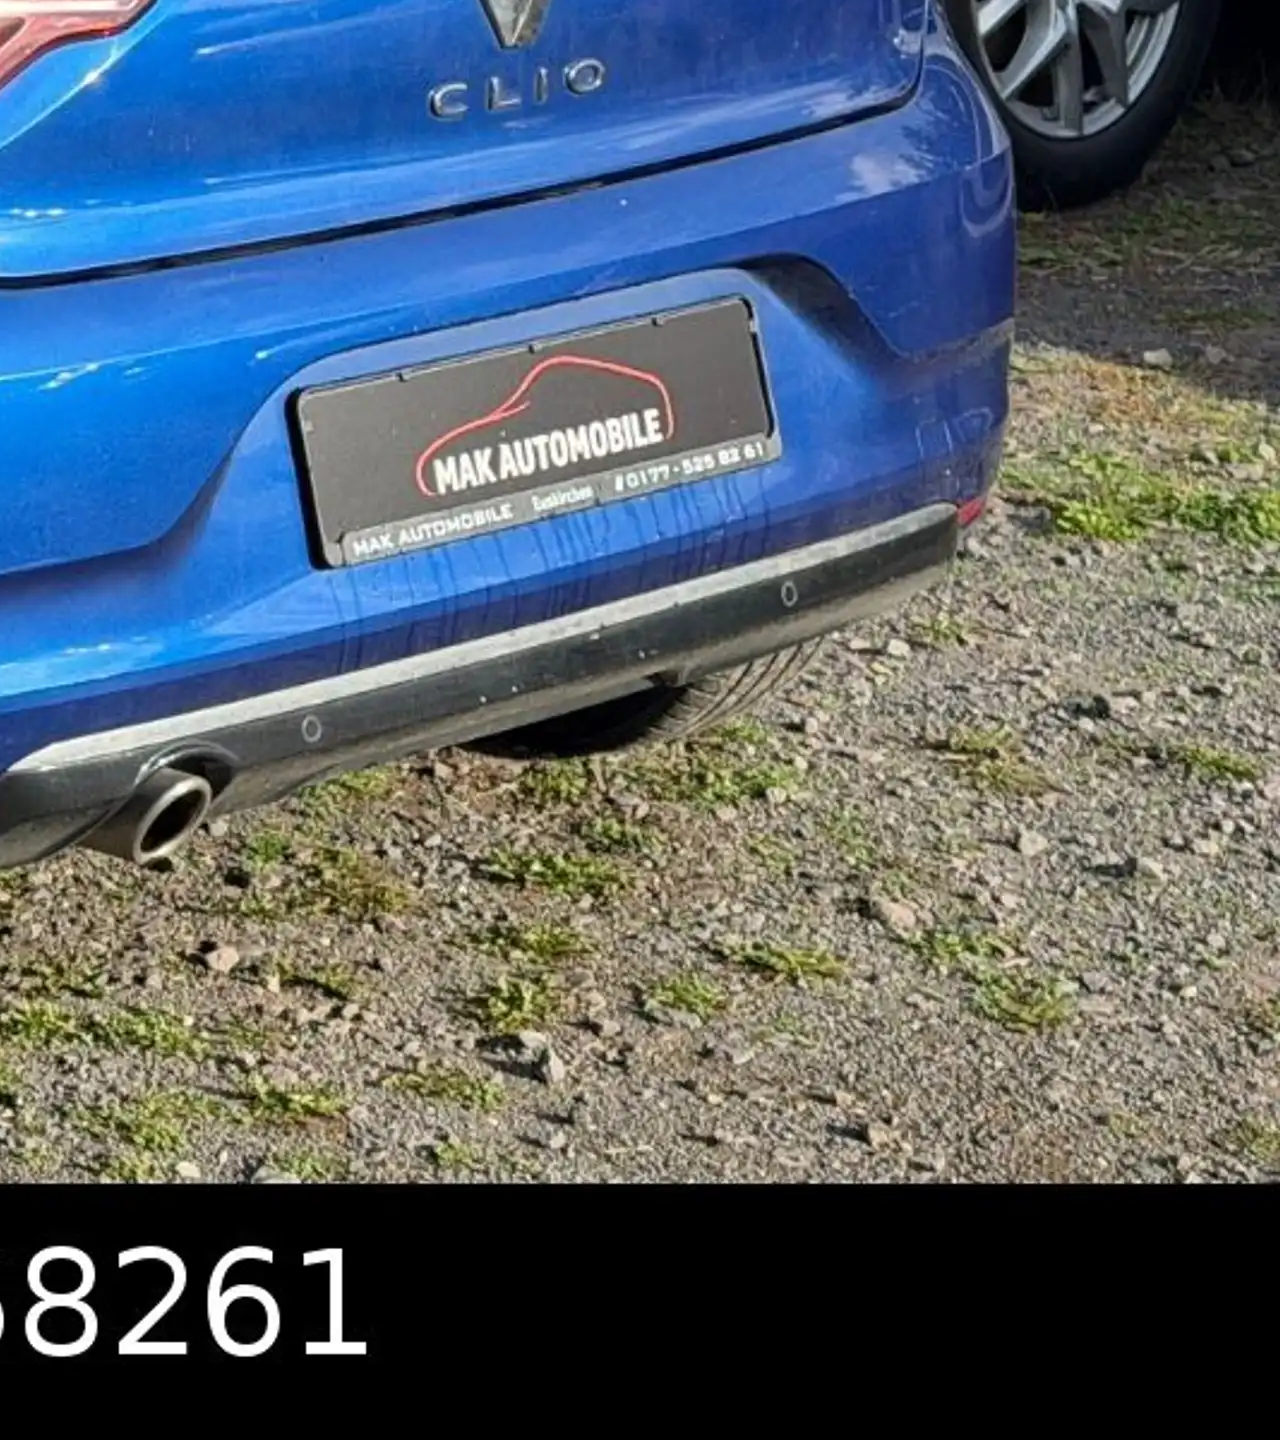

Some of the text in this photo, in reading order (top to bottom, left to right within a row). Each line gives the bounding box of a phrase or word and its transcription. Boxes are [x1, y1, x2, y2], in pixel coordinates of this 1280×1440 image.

[428, 58, 606, 121] CLIO
[433, 408, 663, 495] MAK AUTOMOBILE
[352, 534, 393, 557] MAK
[398, 503, 513, 547] AUTOMOBILE
